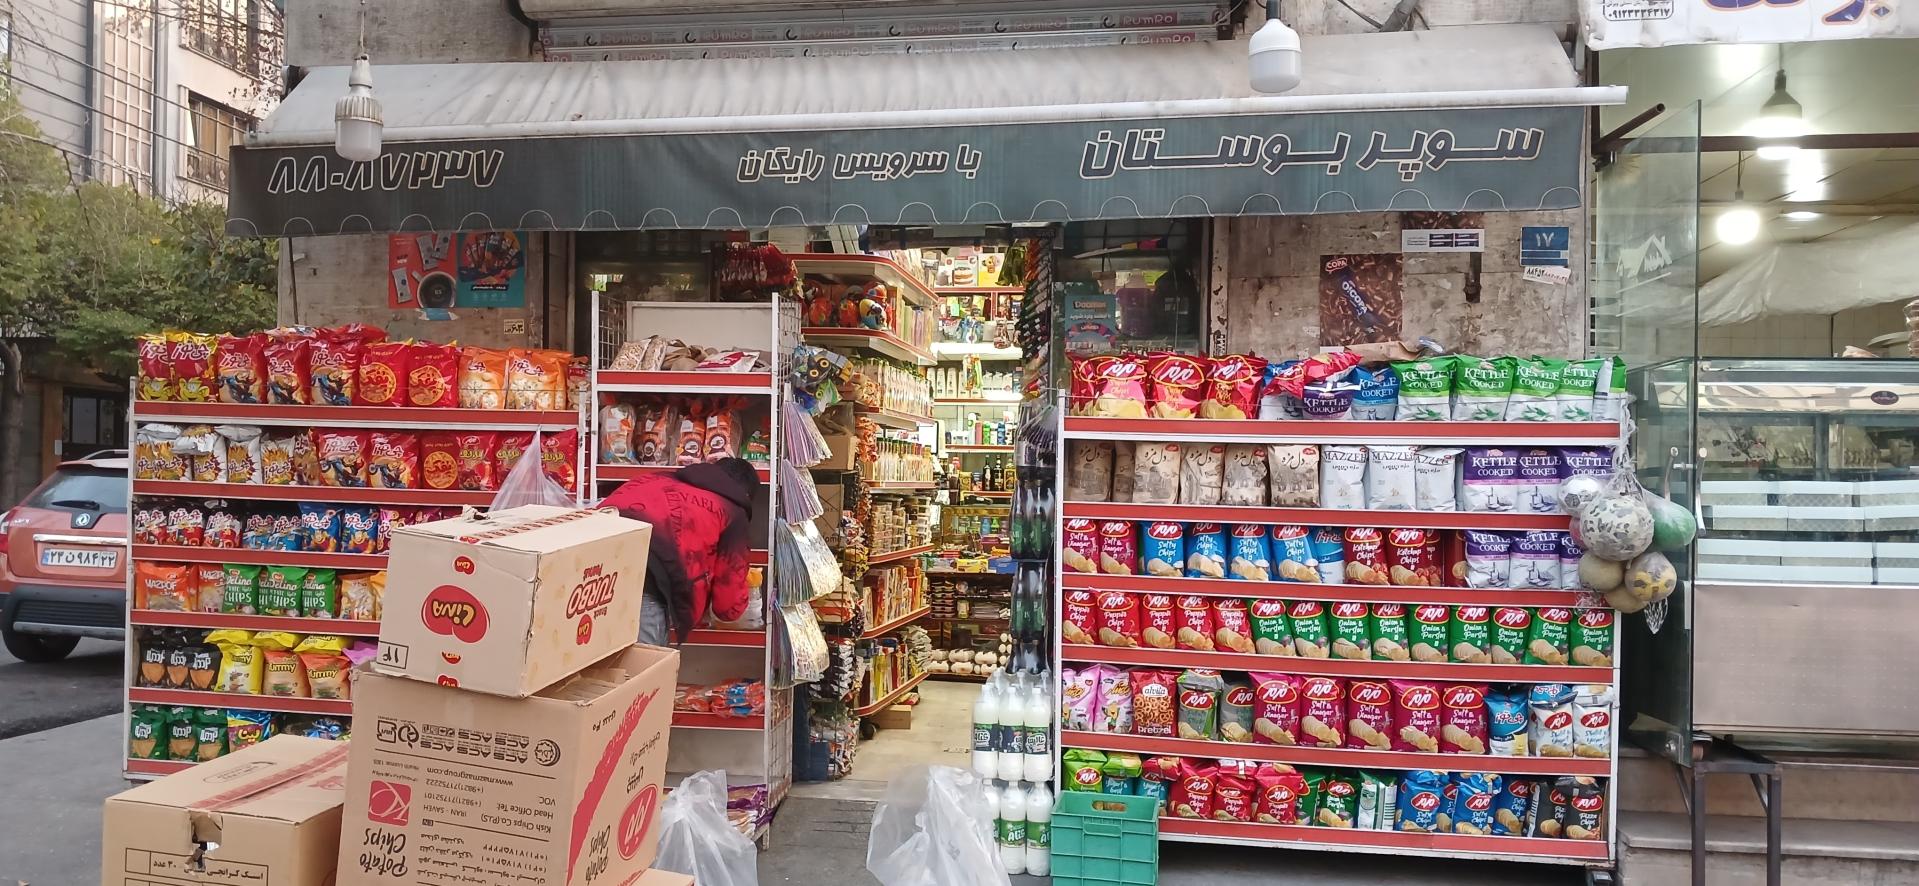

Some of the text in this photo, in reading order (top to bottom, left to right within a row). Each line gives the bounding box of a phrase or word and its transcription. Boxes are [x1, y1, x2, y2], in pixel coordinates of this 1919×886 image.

[1080, 127, 1545, 181] سوپر بوستان
[737, 143, 983, 183] با سرویس رایگان
[1472, 456, 1516, 467] KETTLE
[566, 571, 618, 619] TURBO
[420, 741, 454, 752] ACS
[457, 747, 491, 758] ACS
[494, 752, 528, 764] ACS
[510, 805, 553, 819] Head Office
[514, 820, 534, 830] Chips
[536, 824, 551, 834] Kish
[364, 828, 406, 855] Chips
[360, 851, 408, 877] Potato
